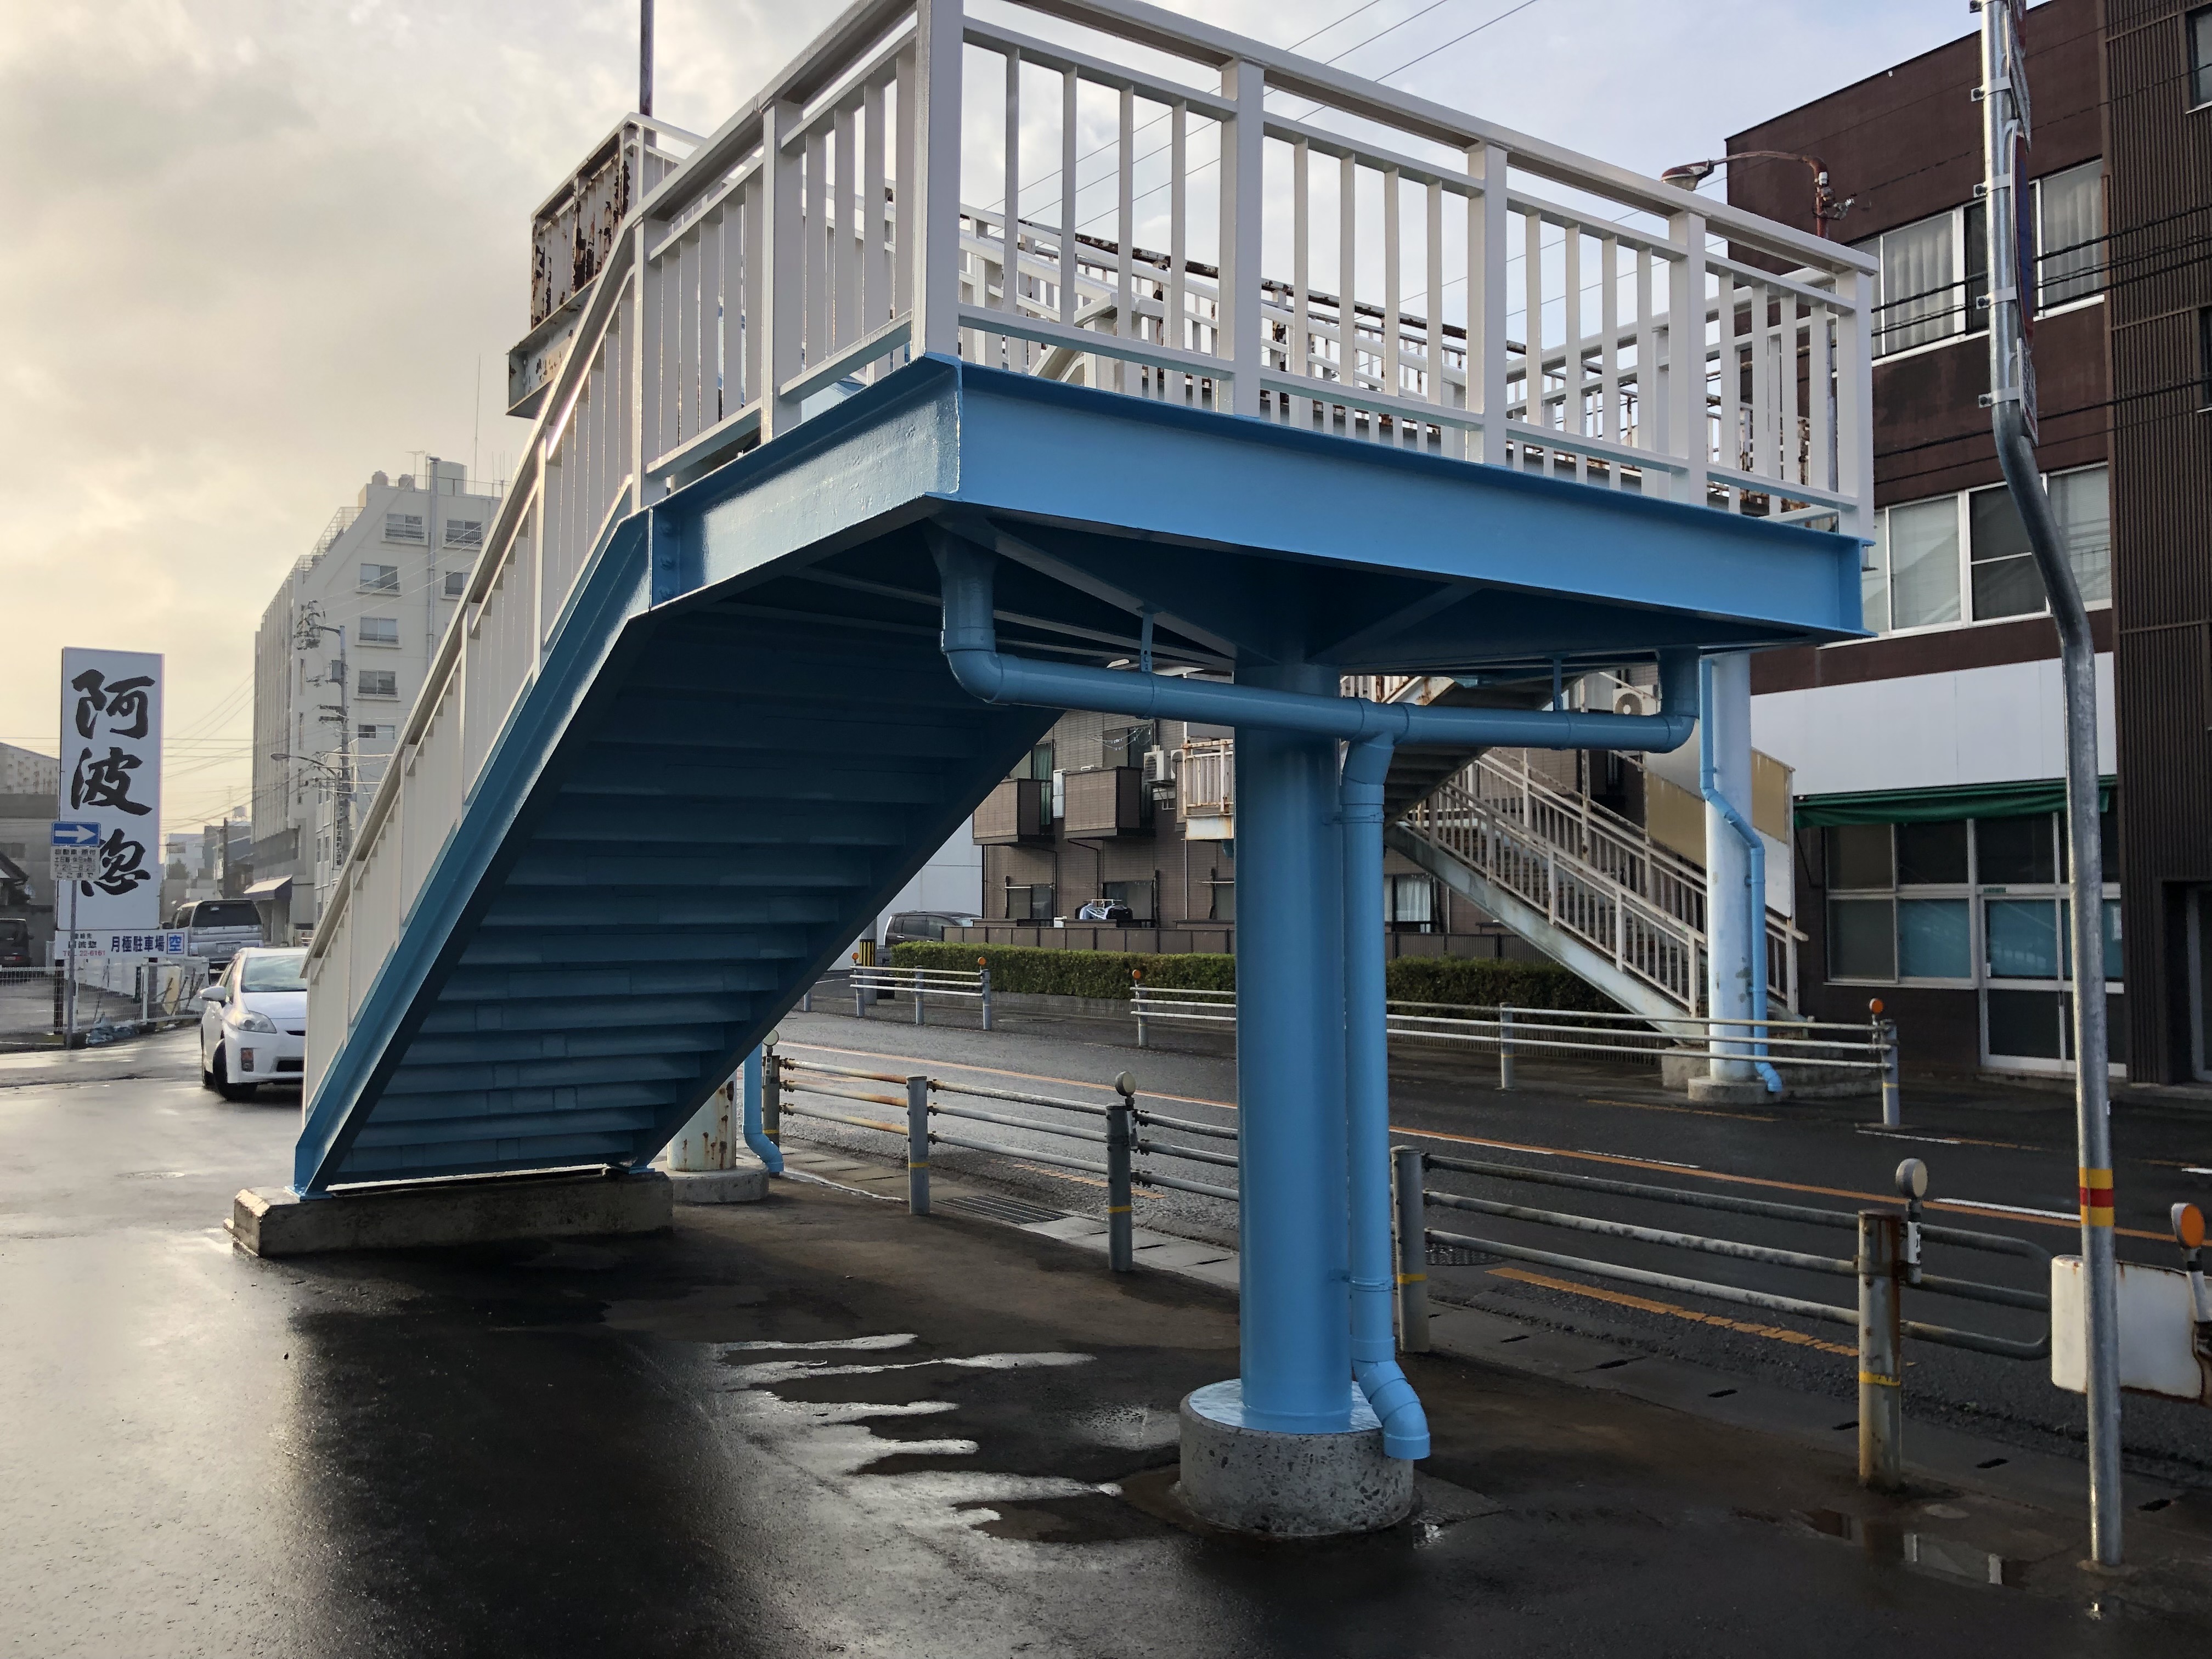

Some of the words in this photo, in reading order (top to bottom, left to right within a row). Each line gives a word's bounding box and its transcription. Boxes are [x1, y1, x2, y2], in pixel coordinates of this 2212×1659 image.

[111, 935, 165, 952] 月極駐車場
[168, 935, 182, 951] 空
